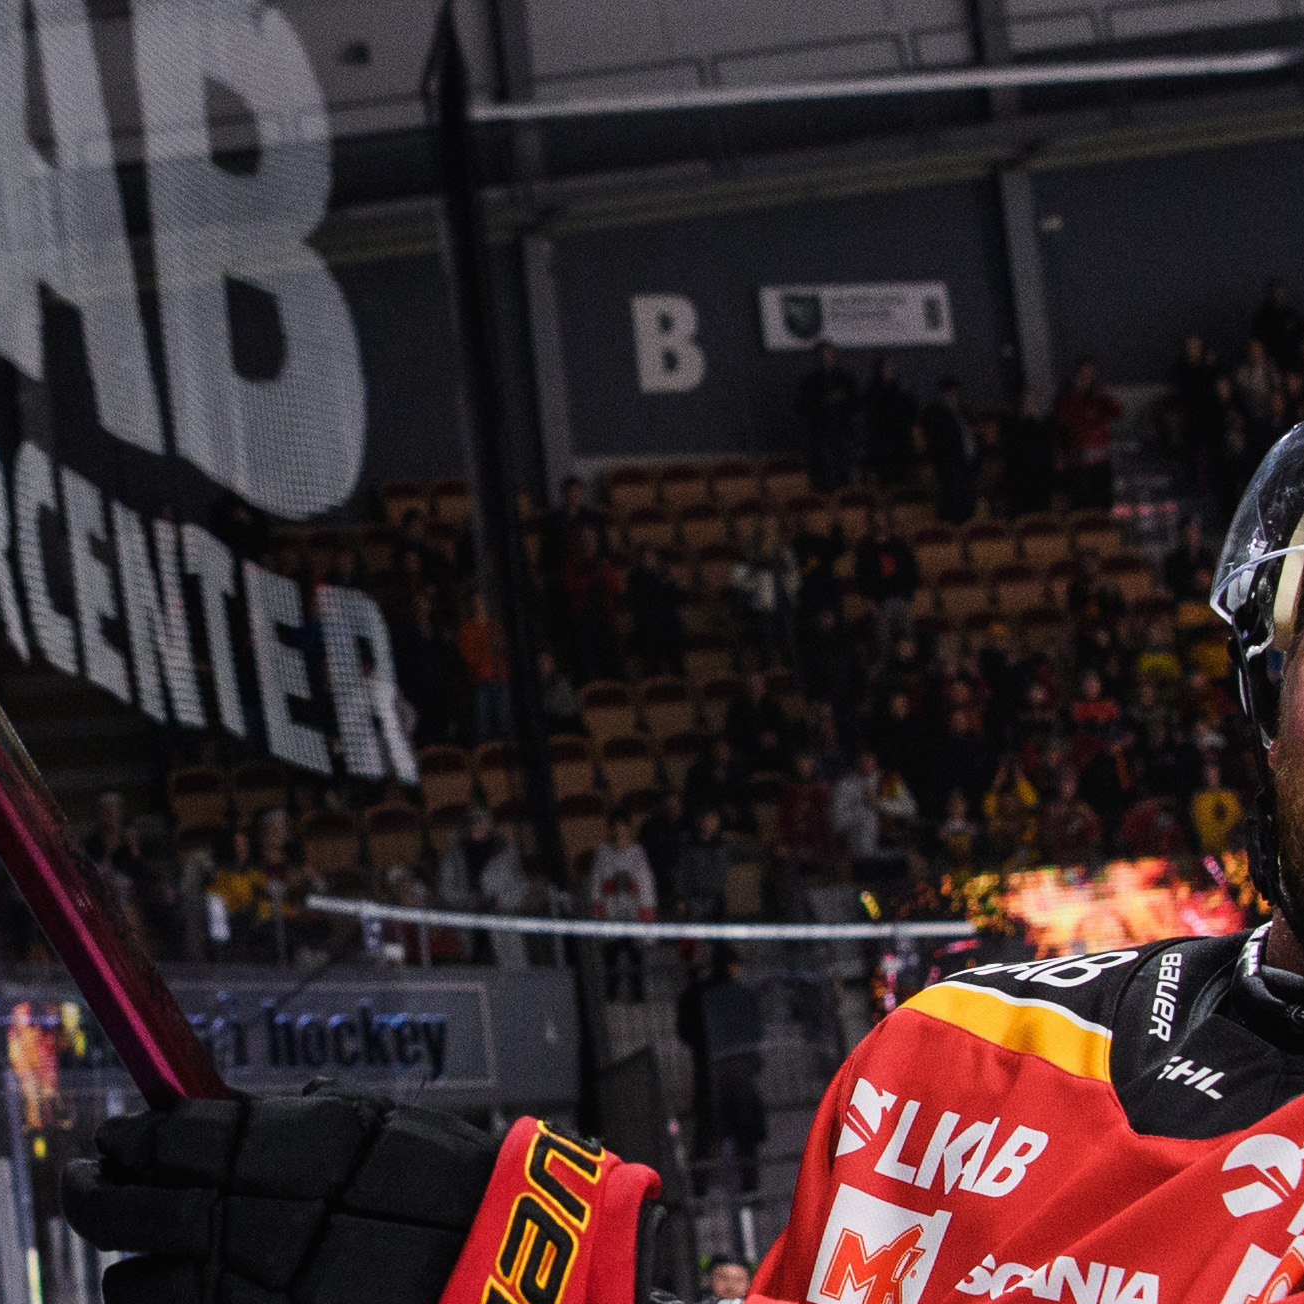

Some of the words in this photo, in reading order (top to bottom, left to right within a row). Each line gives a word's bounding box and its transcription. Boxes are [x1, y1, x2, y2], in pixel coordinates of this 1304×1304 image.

[631, 294, 705, 393] B
[262, 996, 447, 1083] hockey
[874, 1099, 1049, 1198] LKAB
